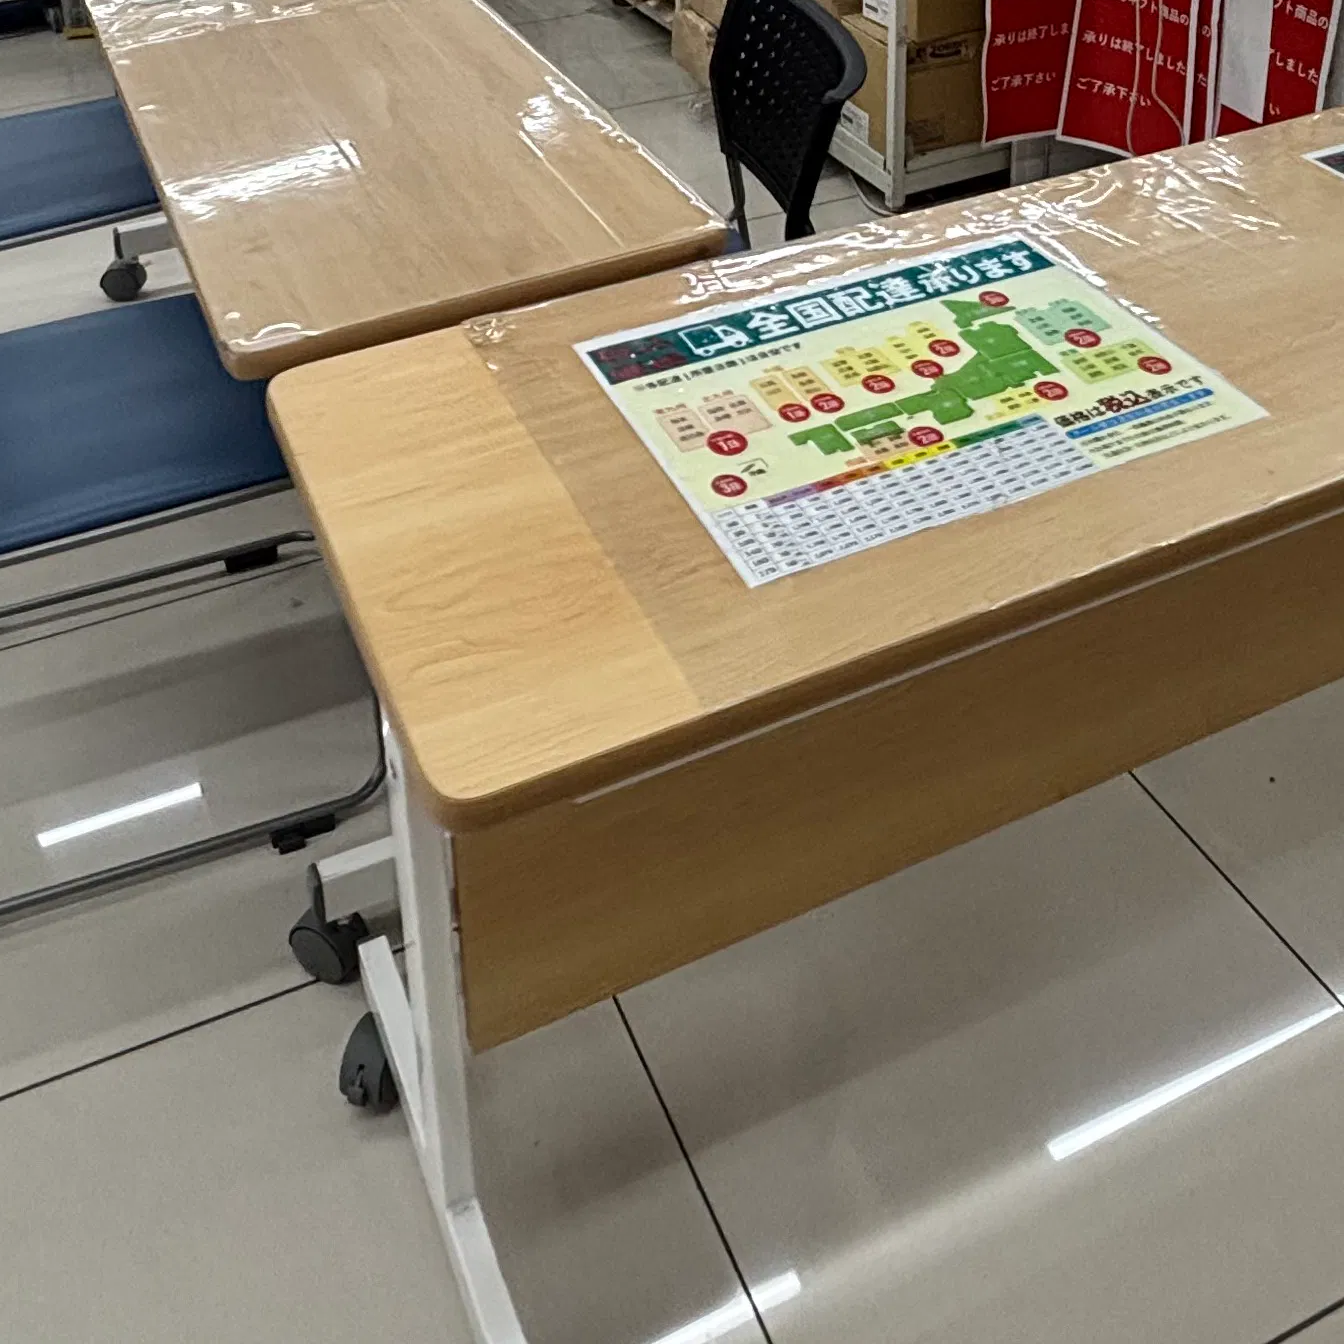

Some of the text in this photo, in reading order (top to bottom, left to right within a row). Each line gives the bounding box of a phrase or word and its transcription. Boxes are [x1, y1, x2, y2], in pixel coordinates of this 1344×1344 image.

[991, 71, 1056, 92] ご了承下さい
[1076, 77, 1151, 107] ご了承下さい
[747, 247, 1038, 340] 全国配達承ります
[1053, 375, 1205, 427] 価格は税込表示です
